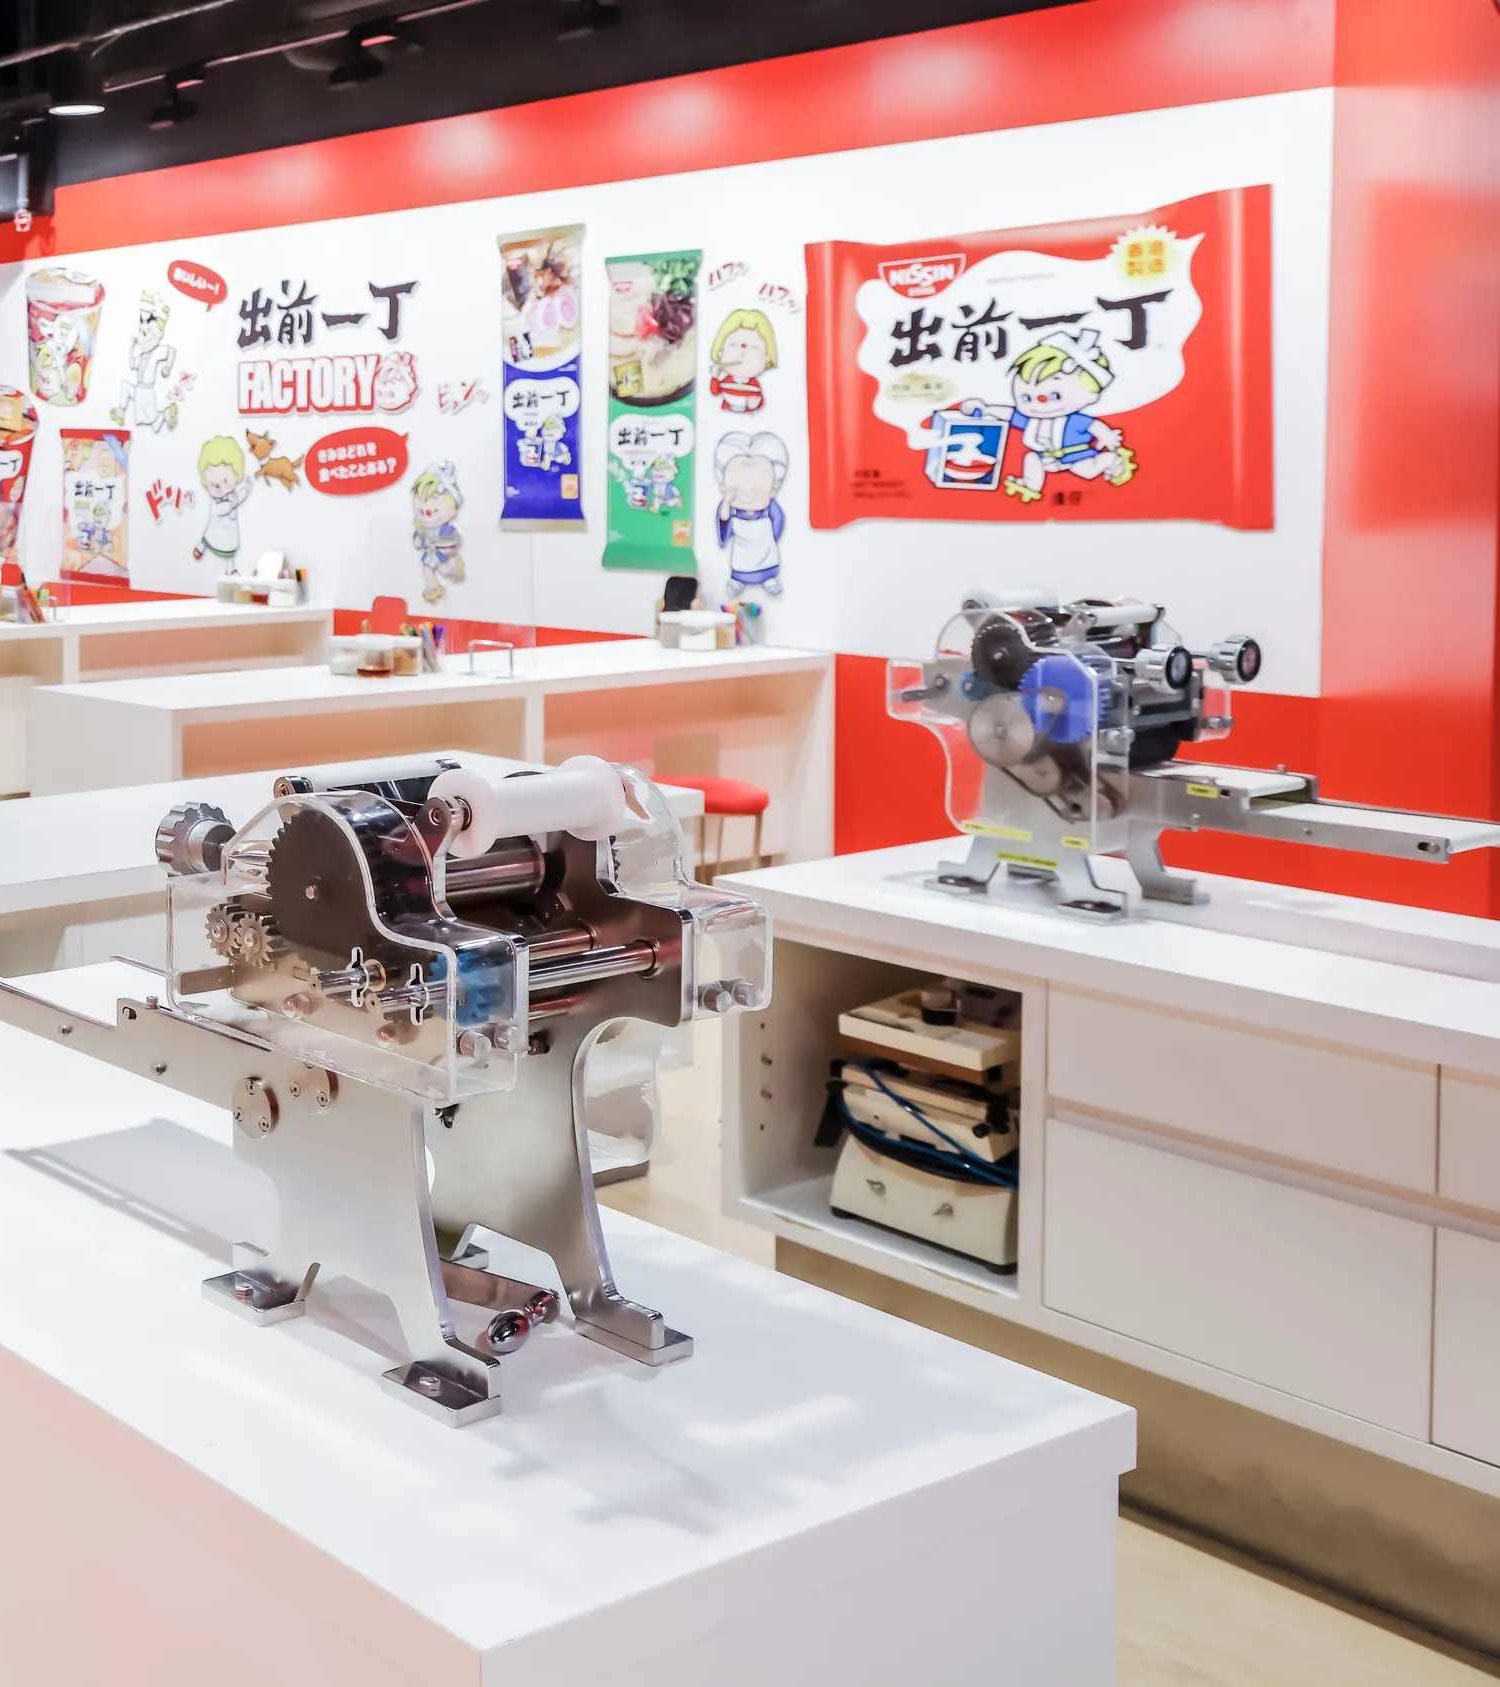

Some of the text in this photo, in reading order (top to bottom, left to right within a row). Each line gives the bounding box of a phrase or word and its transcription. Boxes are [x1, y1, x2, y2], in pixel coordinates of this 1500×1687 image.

[889, 262, 955, 288] NISSIN
[237, 279, 419, 349] 出前一丁
[889, 289, 1175, 368] 出前一丁
[238, 354, 380, 415] FACTORY
[512, 389, 572, 409] 出前一丁
[617, 427, 685, 446] 出前一丁
[74, 480, 116, 500] 出前一丁
